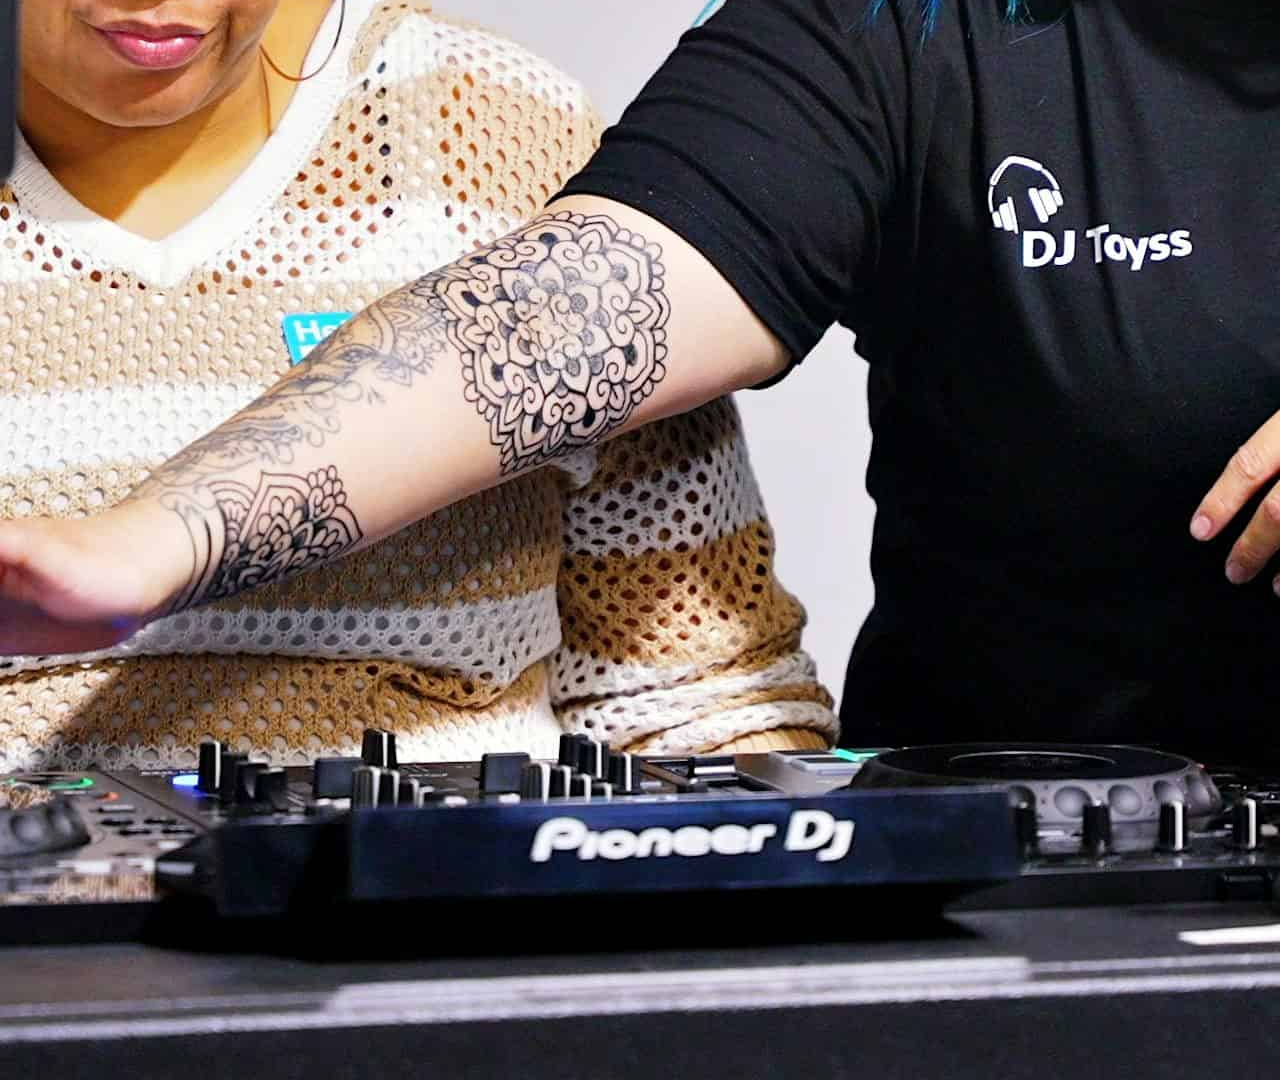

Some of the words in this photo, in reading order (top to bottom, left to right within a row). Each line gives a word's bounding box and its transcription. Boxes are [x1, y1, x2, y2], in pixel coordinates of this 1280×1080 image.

[1022, 230, 1076, 268] DJ
[1086, 224, 1193, 271] Toyss
[530, 816, 776, 862] Pioneer
